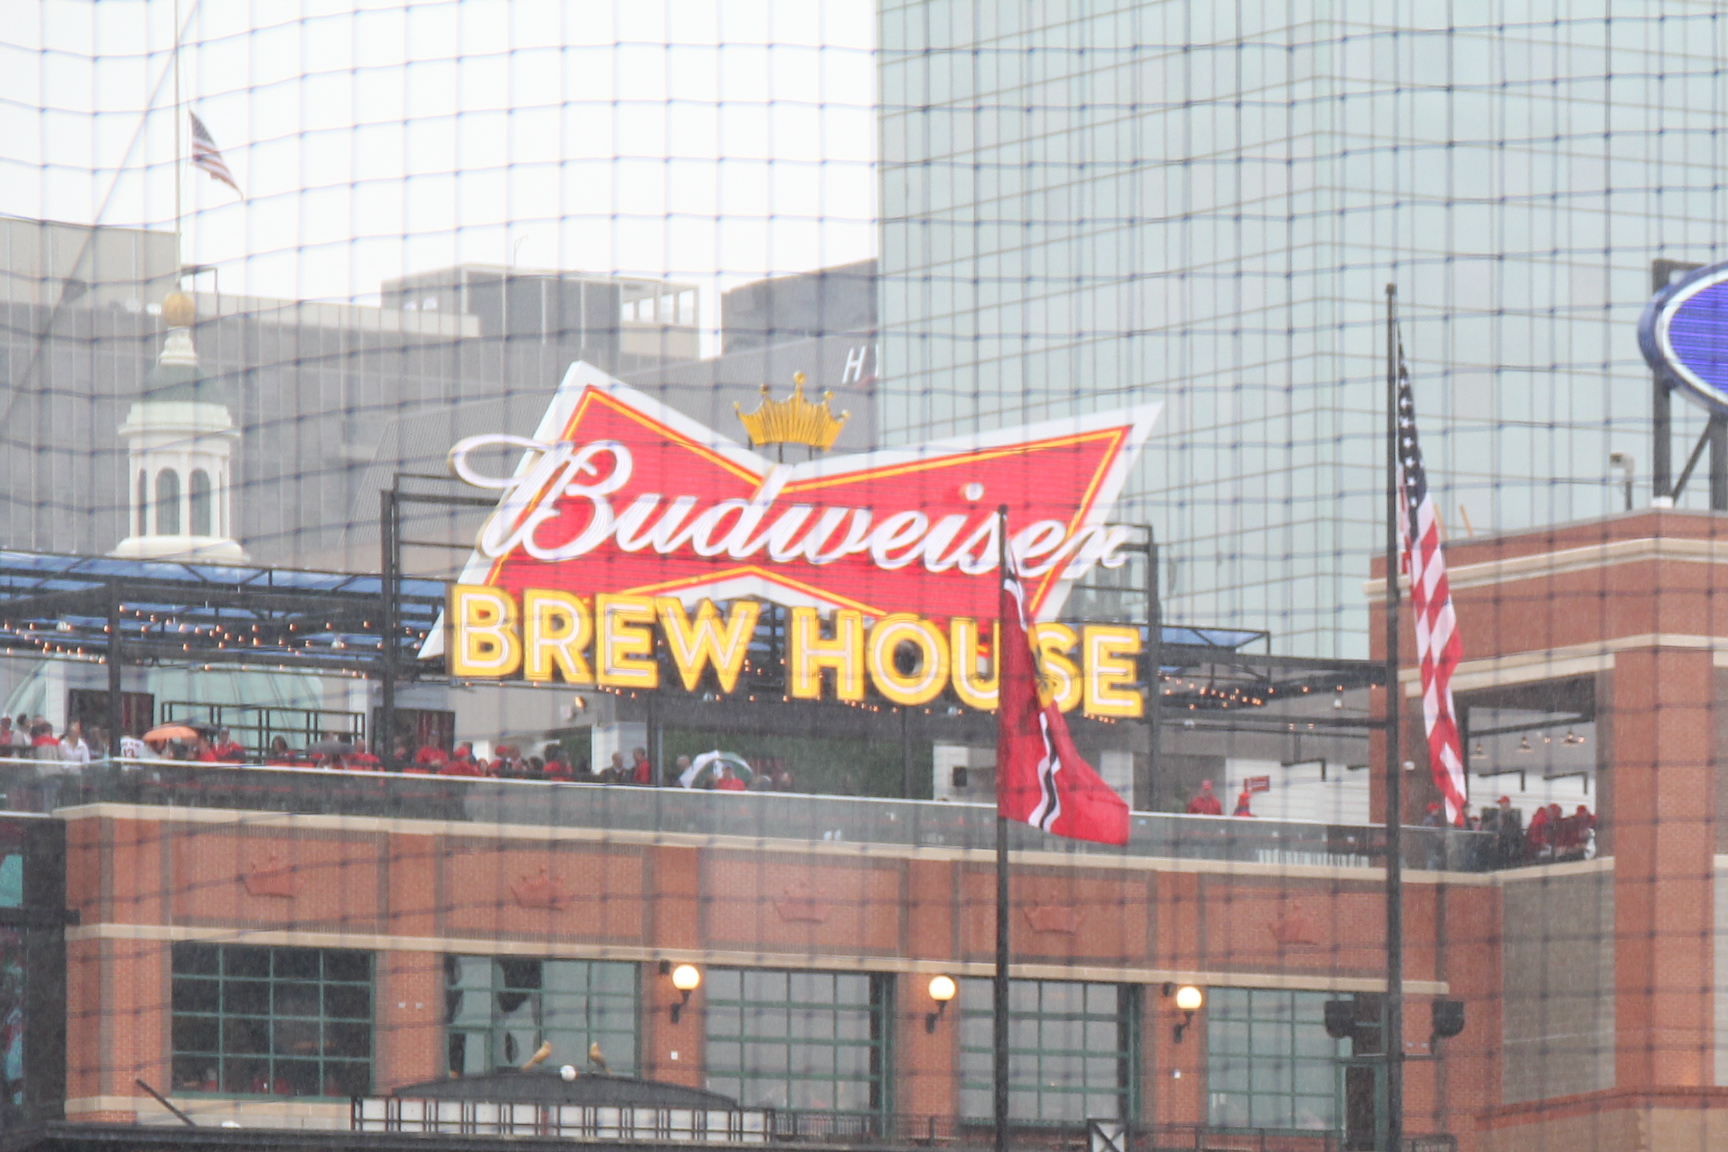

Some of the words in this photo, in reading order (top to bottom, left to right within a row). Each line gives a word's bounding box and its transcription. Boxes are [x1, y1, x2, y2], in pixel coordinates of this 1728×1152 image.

[448, 433, 1133, 578] Budweiser
[452, 586, 758, 693] BREW
[791, 606, 1145, 718] HOUSE
